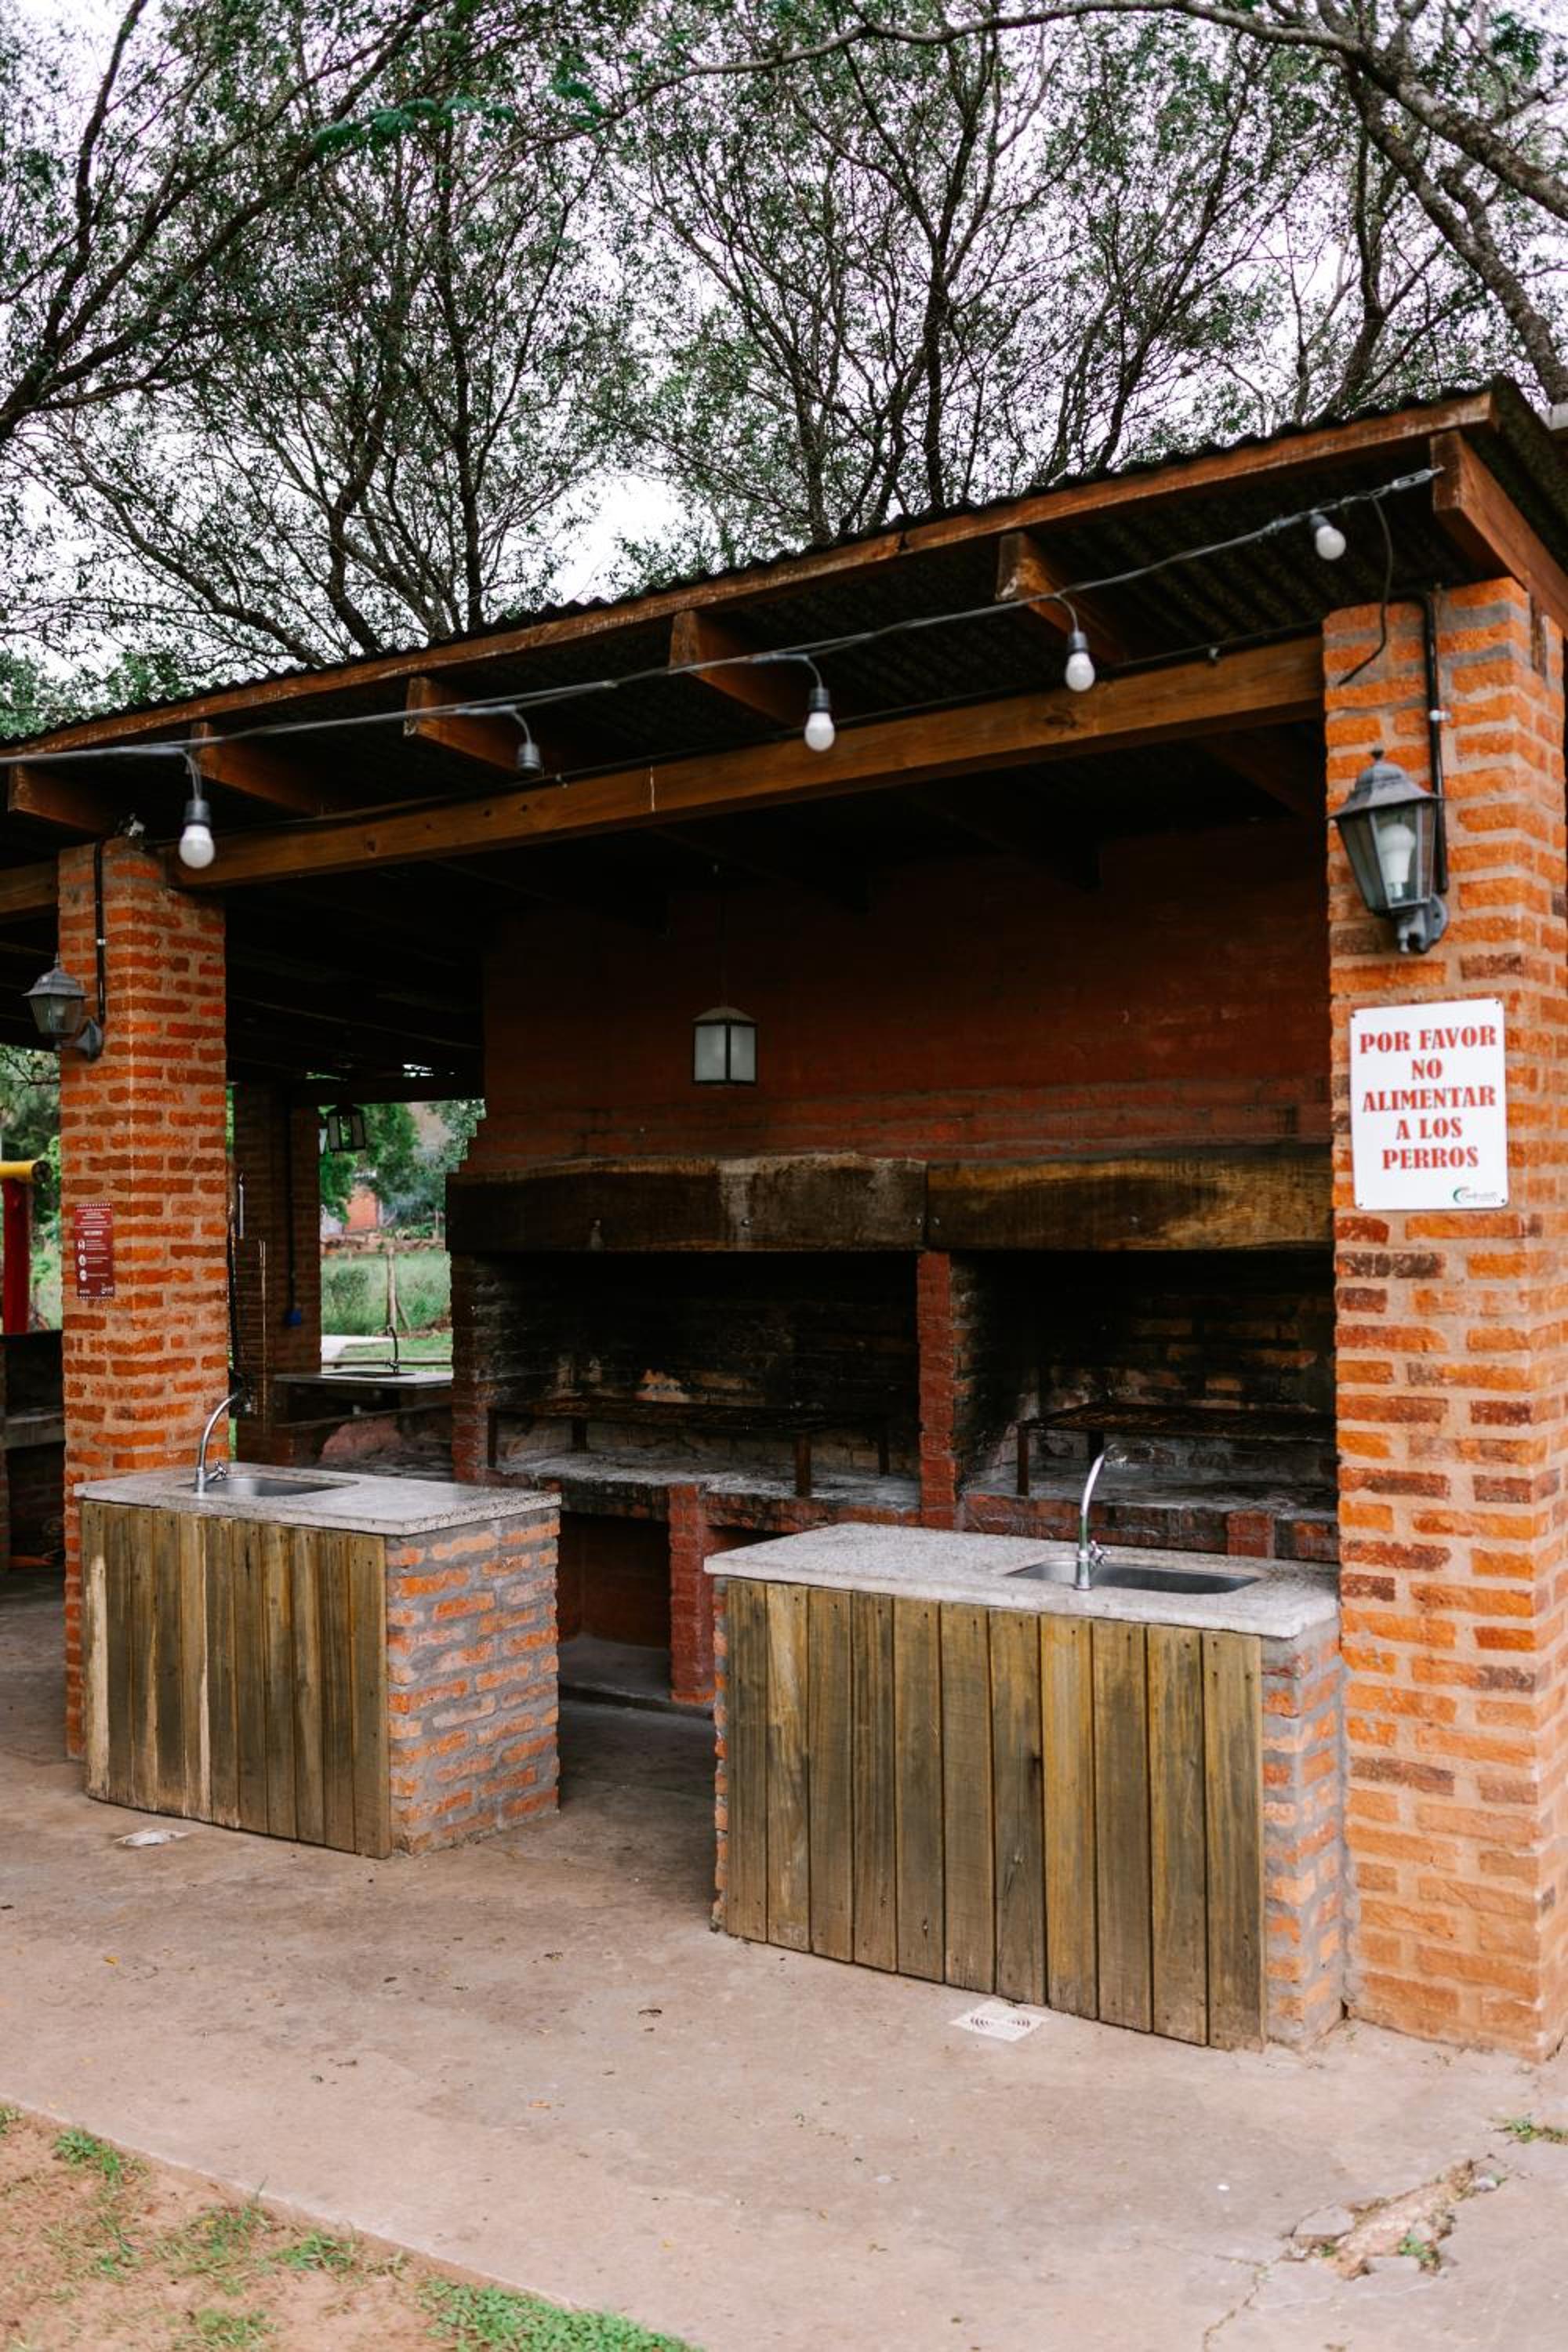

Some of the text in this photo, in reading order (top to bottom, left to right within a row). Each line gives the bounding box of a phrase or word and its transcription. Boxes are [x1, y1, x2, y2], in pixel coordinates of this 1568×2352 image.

[1360, 1025, 1496, 1054] POR FAVOR
[1411, 1059, 1442, 1080] NO
[1363, 1087, 1495, 1112] ALIMENTAR
[1396, 1118, 1462, 1139] A LOS
[1382, 1147, 1478, 1169] PERROS
